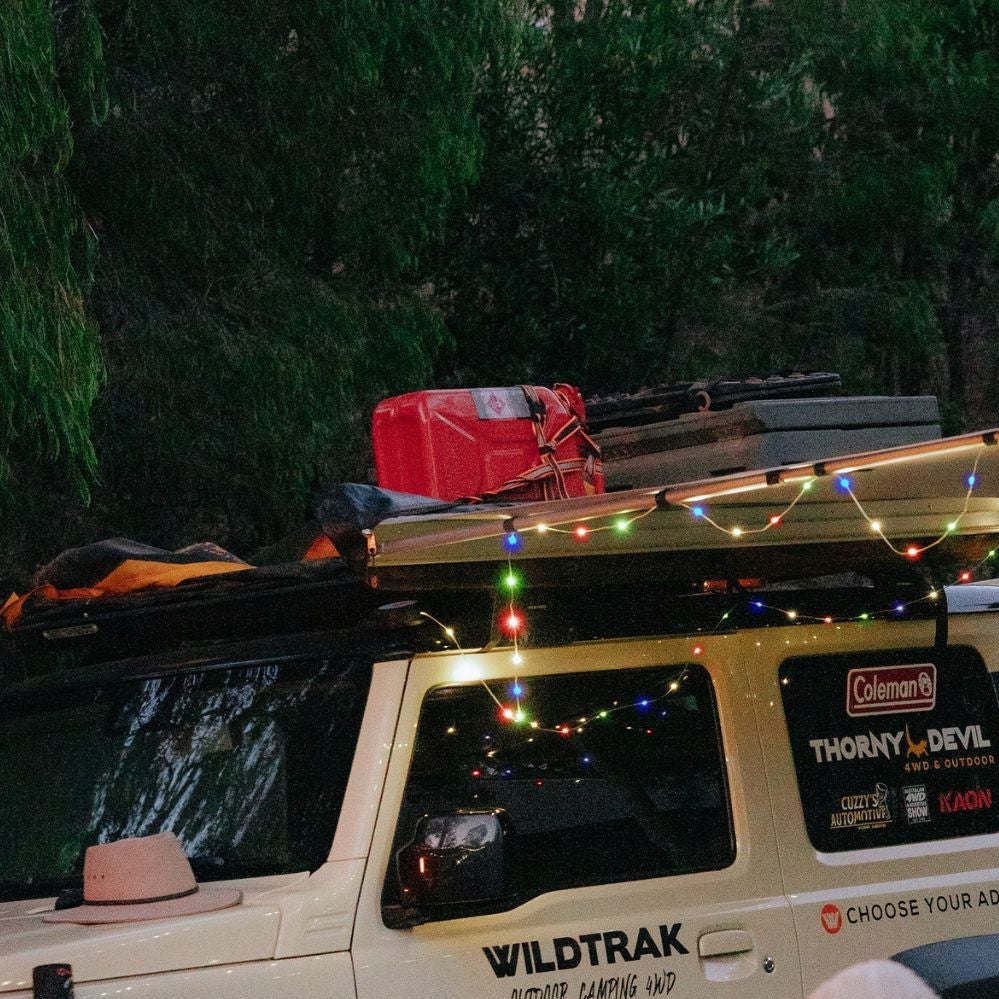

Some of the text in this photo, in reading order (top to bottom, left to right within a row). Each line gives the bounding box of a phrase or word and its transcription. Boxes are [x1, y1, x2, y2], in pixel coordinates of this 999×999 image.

[853, 674, 918, 704] Coleman
[809, 724, 992, 763] THORNY DEVIL
[904, 754, 996, 773] 4WD & OUTDOOR
[841, 793, 879, 811] CUZZY'S
[907, 806, 929, 819] SHOW
[938, 787, 993, 814] KAON
[846, 899, 920, 924] CHOOSE
[924, 893, 973, 913] YOUR
[482, 922, 690, 979] WILDTRAK
[645, 970, 677, 997] 4WD
